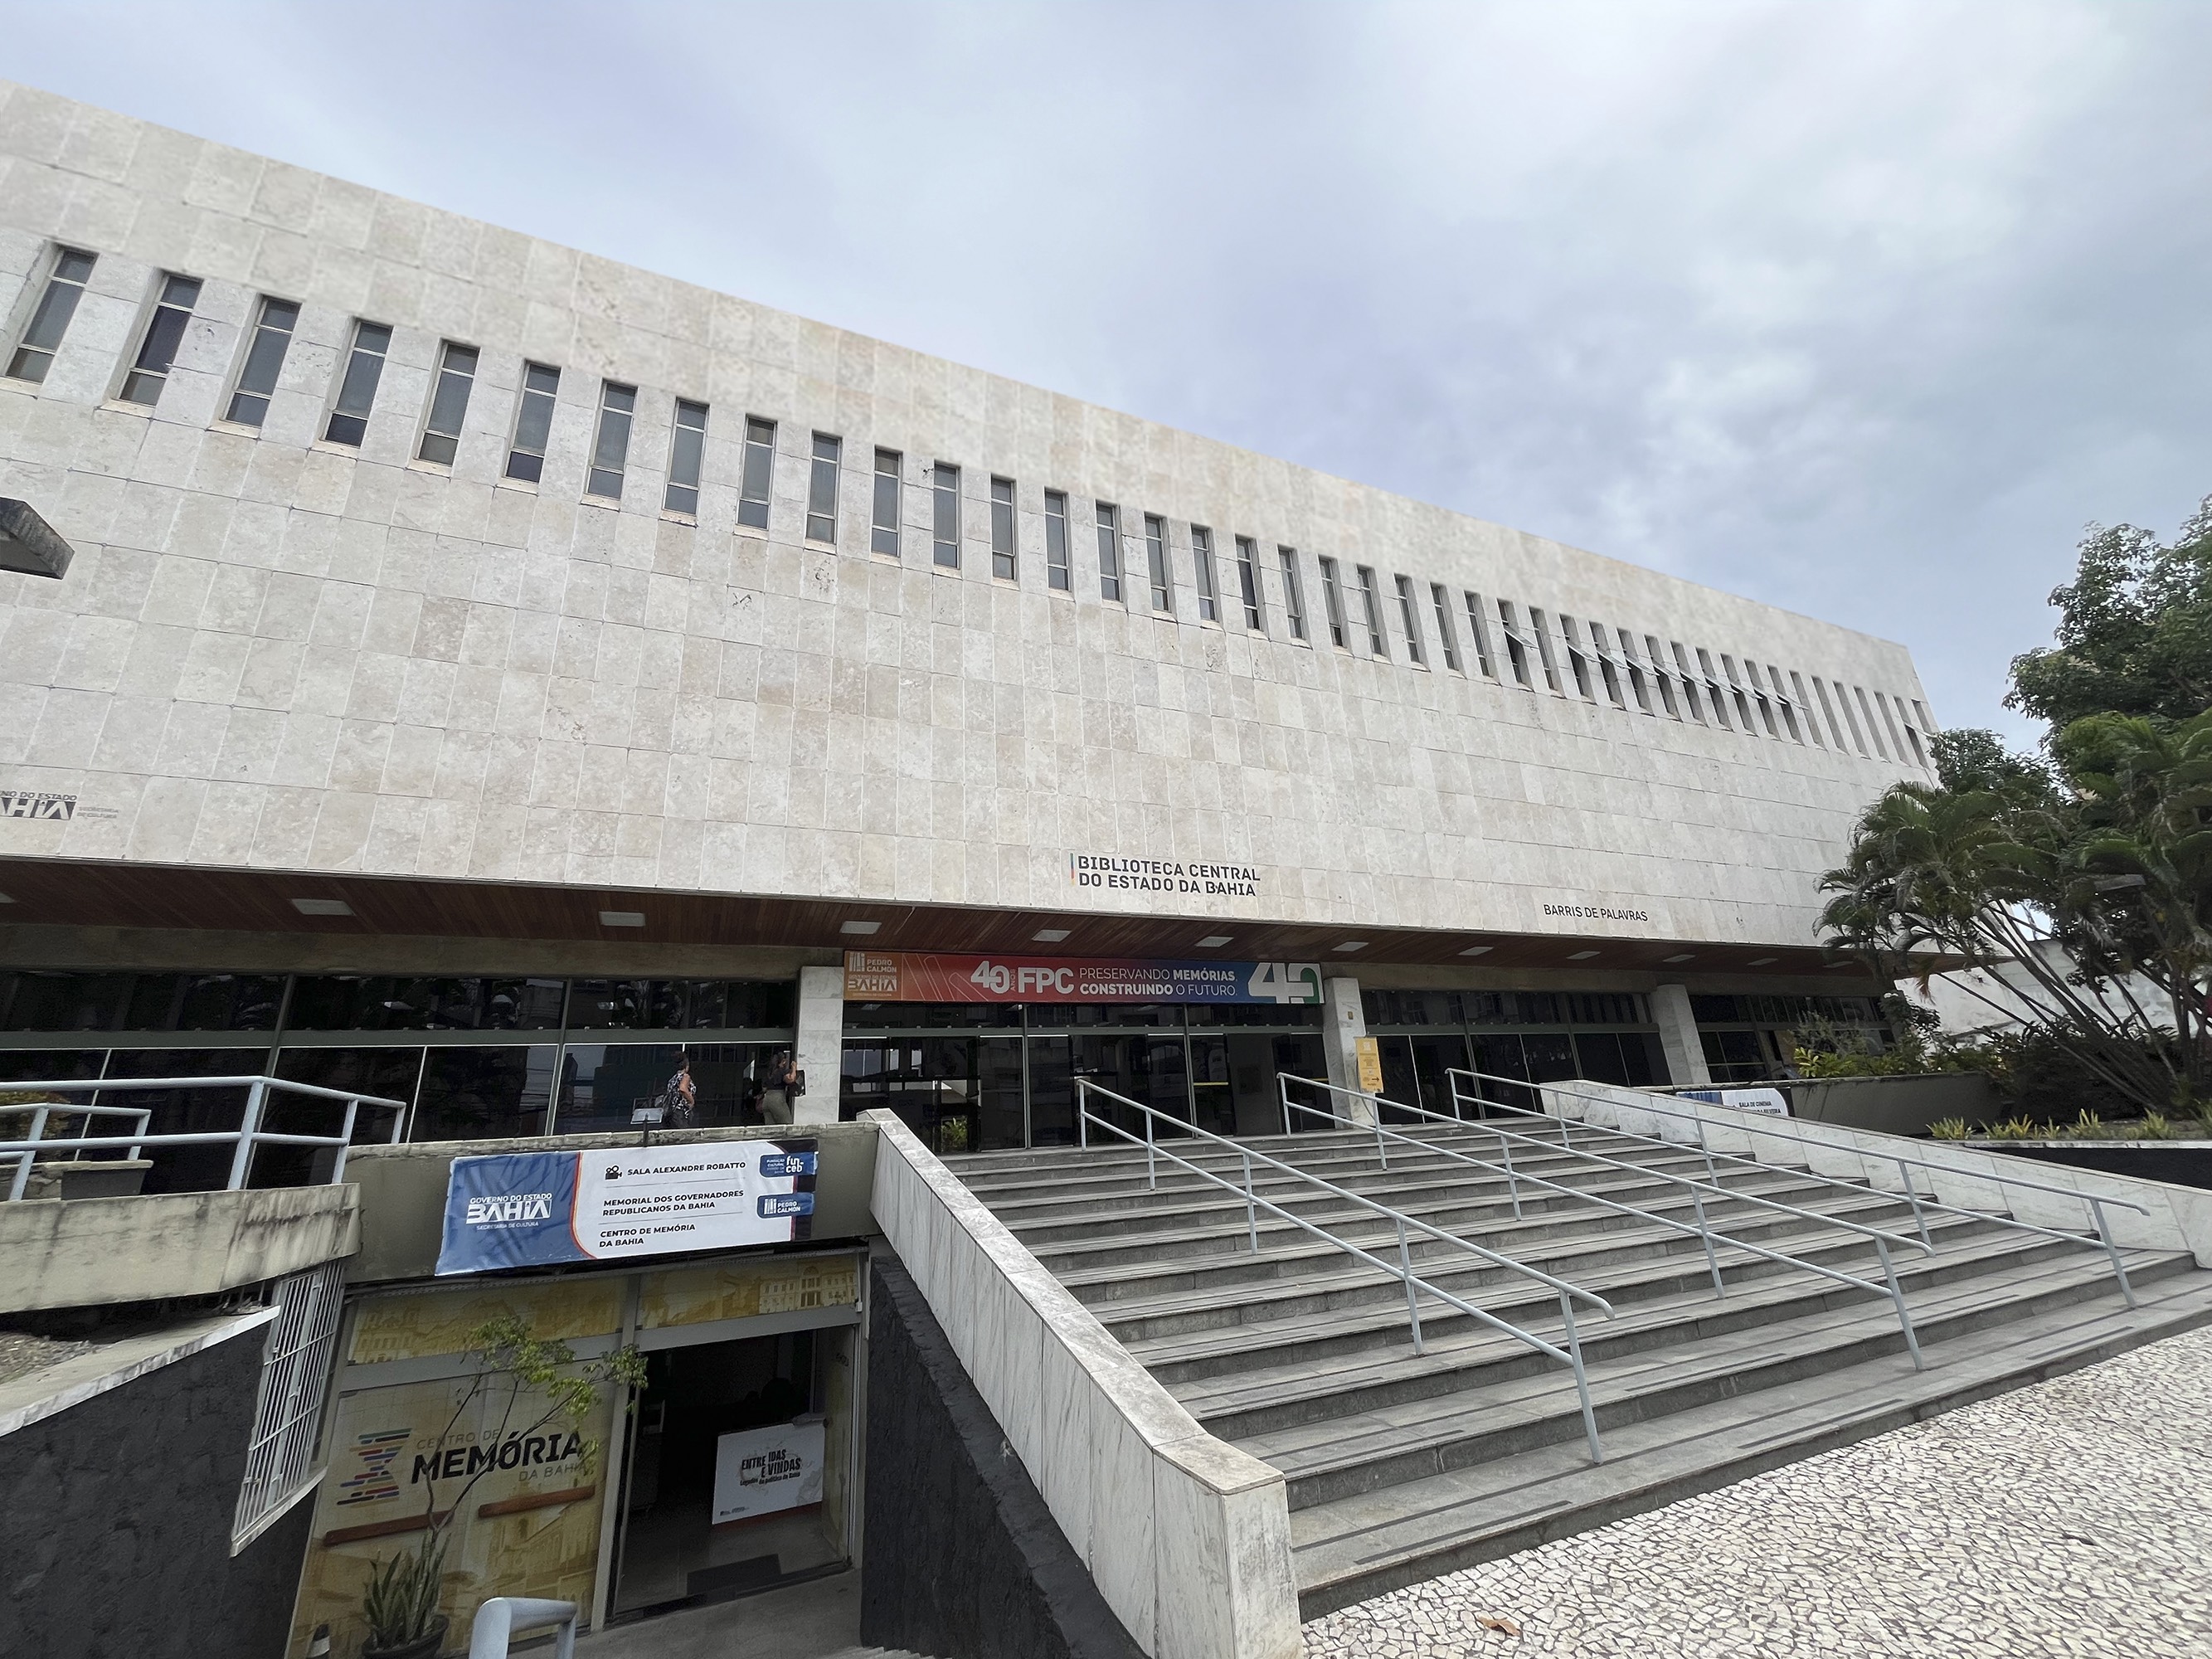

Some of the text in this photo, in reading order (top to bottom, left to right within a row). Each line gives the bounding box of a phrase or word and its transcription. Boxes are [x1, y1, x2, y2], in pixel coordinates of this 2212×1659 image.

[38, 793, 77, 801] ESTADO
[1078, 855, 1261, 881] BIBLIOTECA CENTRAL
[1079, 873, 1257, 897] DO ESTADO DA BAHIA
[1544, 904, 1648, 922] BARRIS DE PALAVRAS
[970, 961, 1010, 994] 40
[1018, 967, 1075, 995] FPC
[1079, 967, 1170, 980] PRESERVANDO
[1079, 983, 1174, 995] CONSTRUINDO
[1175, 985, 1186, 995] O
[653, 1165, 705, 1175] ALEXANDRE
[707, 1162, 746, 1170] ROBATTO
[785, 1165, 803, 1174] ceb
[469, 1196, 508, 1204] GOVERNO
[523, 1193, 552, 1201] ESTADO
[603, 1197, 652, 1207] MEMORIAL
[674, 1190, 744, 1201] GOVERNADORES
[602, 1205, 671, 1217] REPUBLICANOS
[688, 1202, 715, 1210] BAHIA
[600, 1228, 637, 1238] CENTRO
[654, 1224, 695, 1233] MEMÓRIA
[615, 1238, 644, 1246] BAHIA
[417, 1429, 500, 1450] CENTRO DE
[411, 1430, 582, 1485] MEMÓRIA
[741, 1449, 786, 1470] ENTRE IDAS
[761, 1457, 801, 1477] E VINDAS
[518, 1470, 538, 1481] DA
